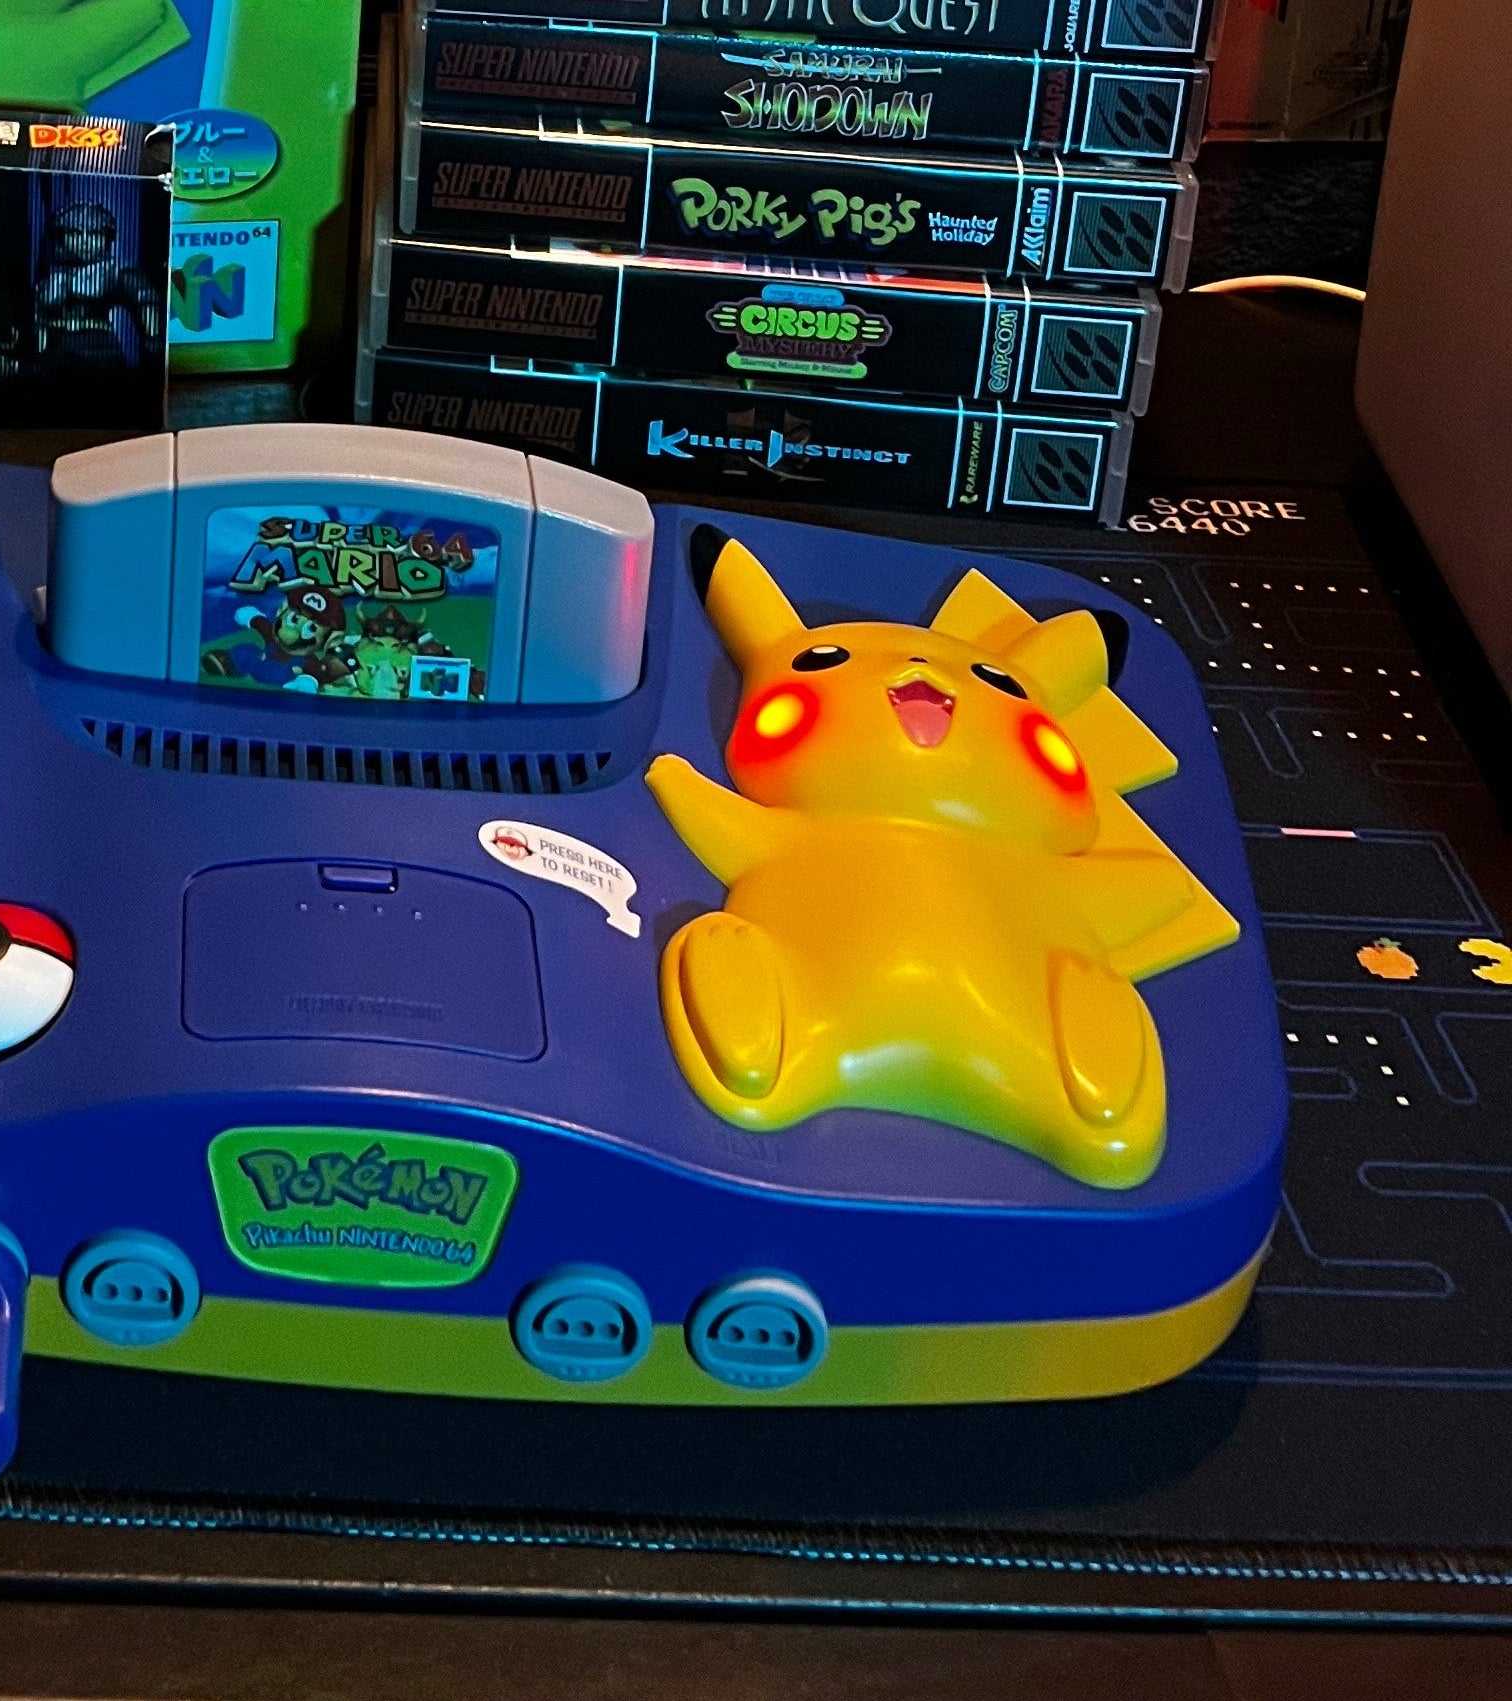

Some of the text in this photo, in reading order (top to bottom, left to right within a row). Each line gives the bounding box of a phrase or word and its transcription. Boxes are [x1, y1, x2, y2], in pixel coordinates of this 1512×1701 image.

[439, 43, 639, 88] SUPER NINTENDO
[763, 50, 903, 83] SAMURAI
[721, 79, 932, 140] SHODOWN
[28, 124, 122, 149] DK64
[197, 146, 215, 164] &
[179, 166, 257, 186] エロー
[434, 162, 512, 197] SUPER
[514, 168, 633, 210] NINTENDO
[172, 225, 271, 248] TENDO 64
[928, 211, 998, 232] Haunted
[931, 228, 995, 246] Holiday
[405, 278, 483, 316] SUPER
[487, 285, 603, 326] NINTENDO
[740, 304, 860, 342] CIRCUS
[988, 309, 1019, 393] CAPCOM
[388, 391, 582, 439] SUPER NINTENDO
[647, 419, 912, 468] KILLER INSTINCT
[965, 421, 983, 494] RAREWARE
[1106, 514, 1252, 537] 6440
[1148, 497, 1306, 520] SCORE
[258, 517, 404, 549] SUPER
[410, 530, 474, 571] 64
[229, 542, 445, 600] MARIO
[540, 839, 623, 880] PRESS HERE
[541, 856, 559, 871] TO
[563, 864, 606, 889] RESET
[243, 1220, 333, 1250] Pikachu
